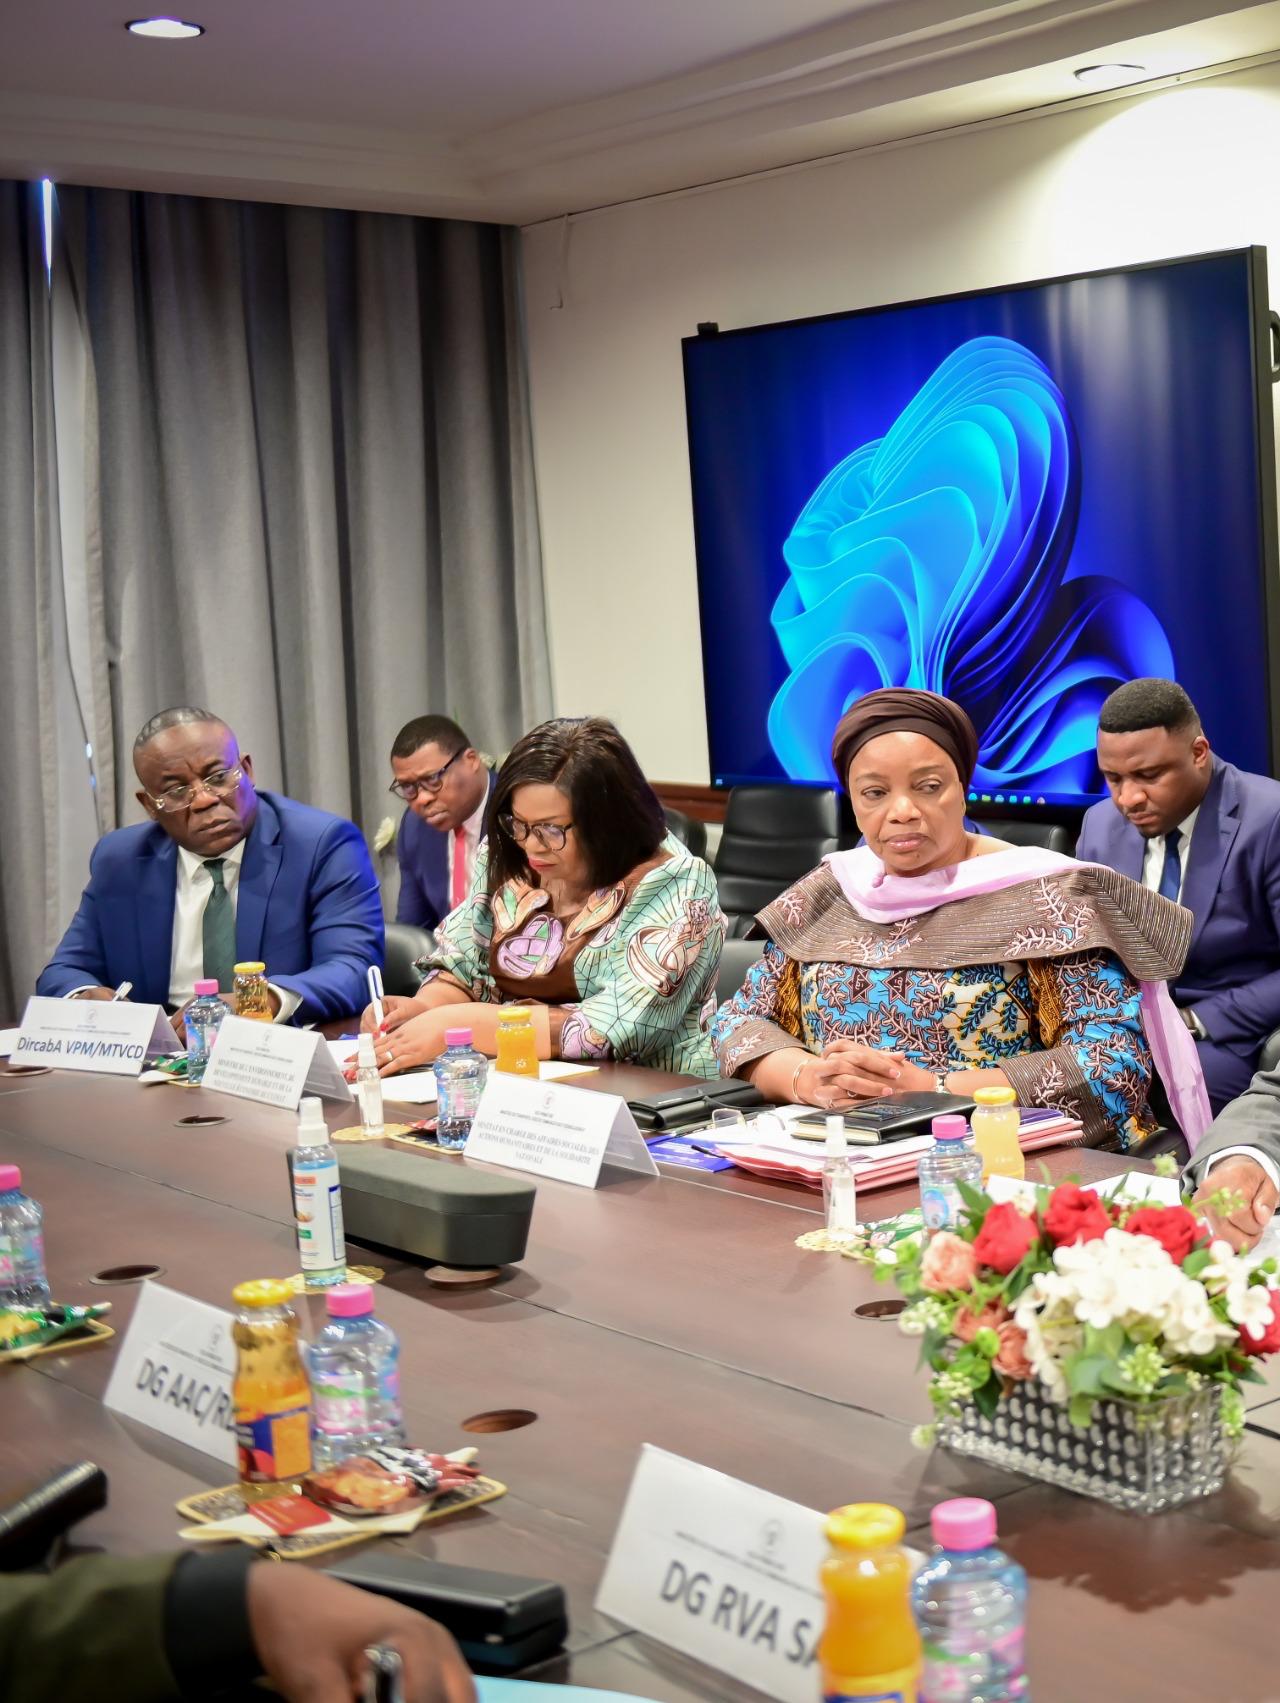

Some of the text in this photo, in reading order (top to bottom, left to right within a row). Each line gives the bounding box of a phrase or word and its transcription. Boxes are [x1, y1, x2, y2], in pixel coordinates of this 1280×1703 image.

[17, 1037, 144, 1059] DircabA VPM/MTVCD
[136, 1357, 169, 1398] DG
[163, 1372, 237, 1432] AAC/R
[660, 1559, 712, 1616] DG
[712, 1584, 780, 1653] RVA
